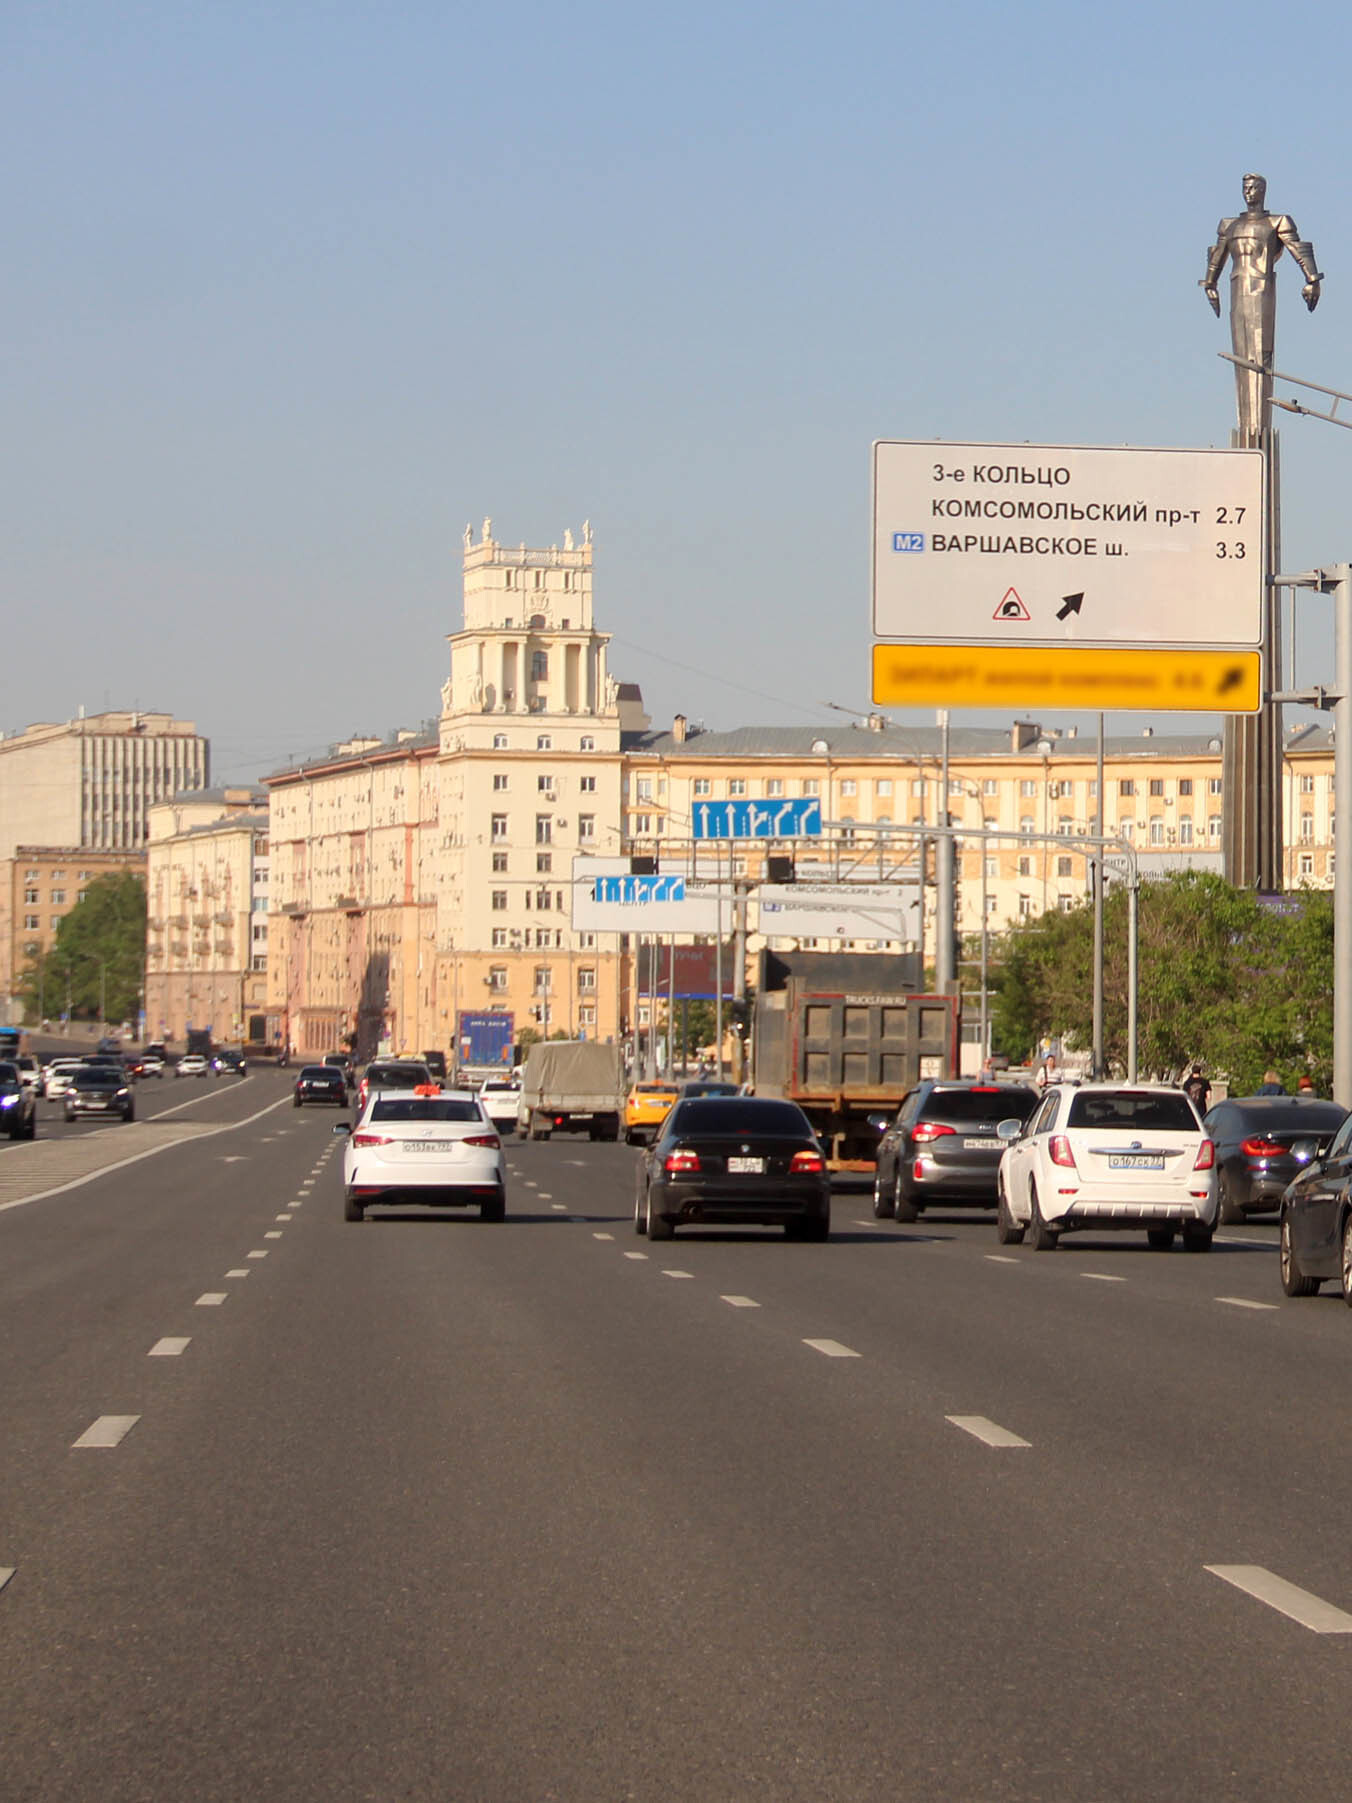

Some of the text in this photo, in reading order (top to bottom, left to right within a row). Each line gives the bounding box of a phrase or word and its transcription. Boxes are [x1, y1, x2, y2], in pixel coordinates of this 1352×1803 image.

[933, 463, 1071, 489] 3-е КОЛЬЦО
[932, 499, 1247, 528] КОМСОМОЛЬСКИЙ пр-т 2.7
[895, 534, 1246, 560] М2 ВАРШАВСКОЕ ш. 3.3
